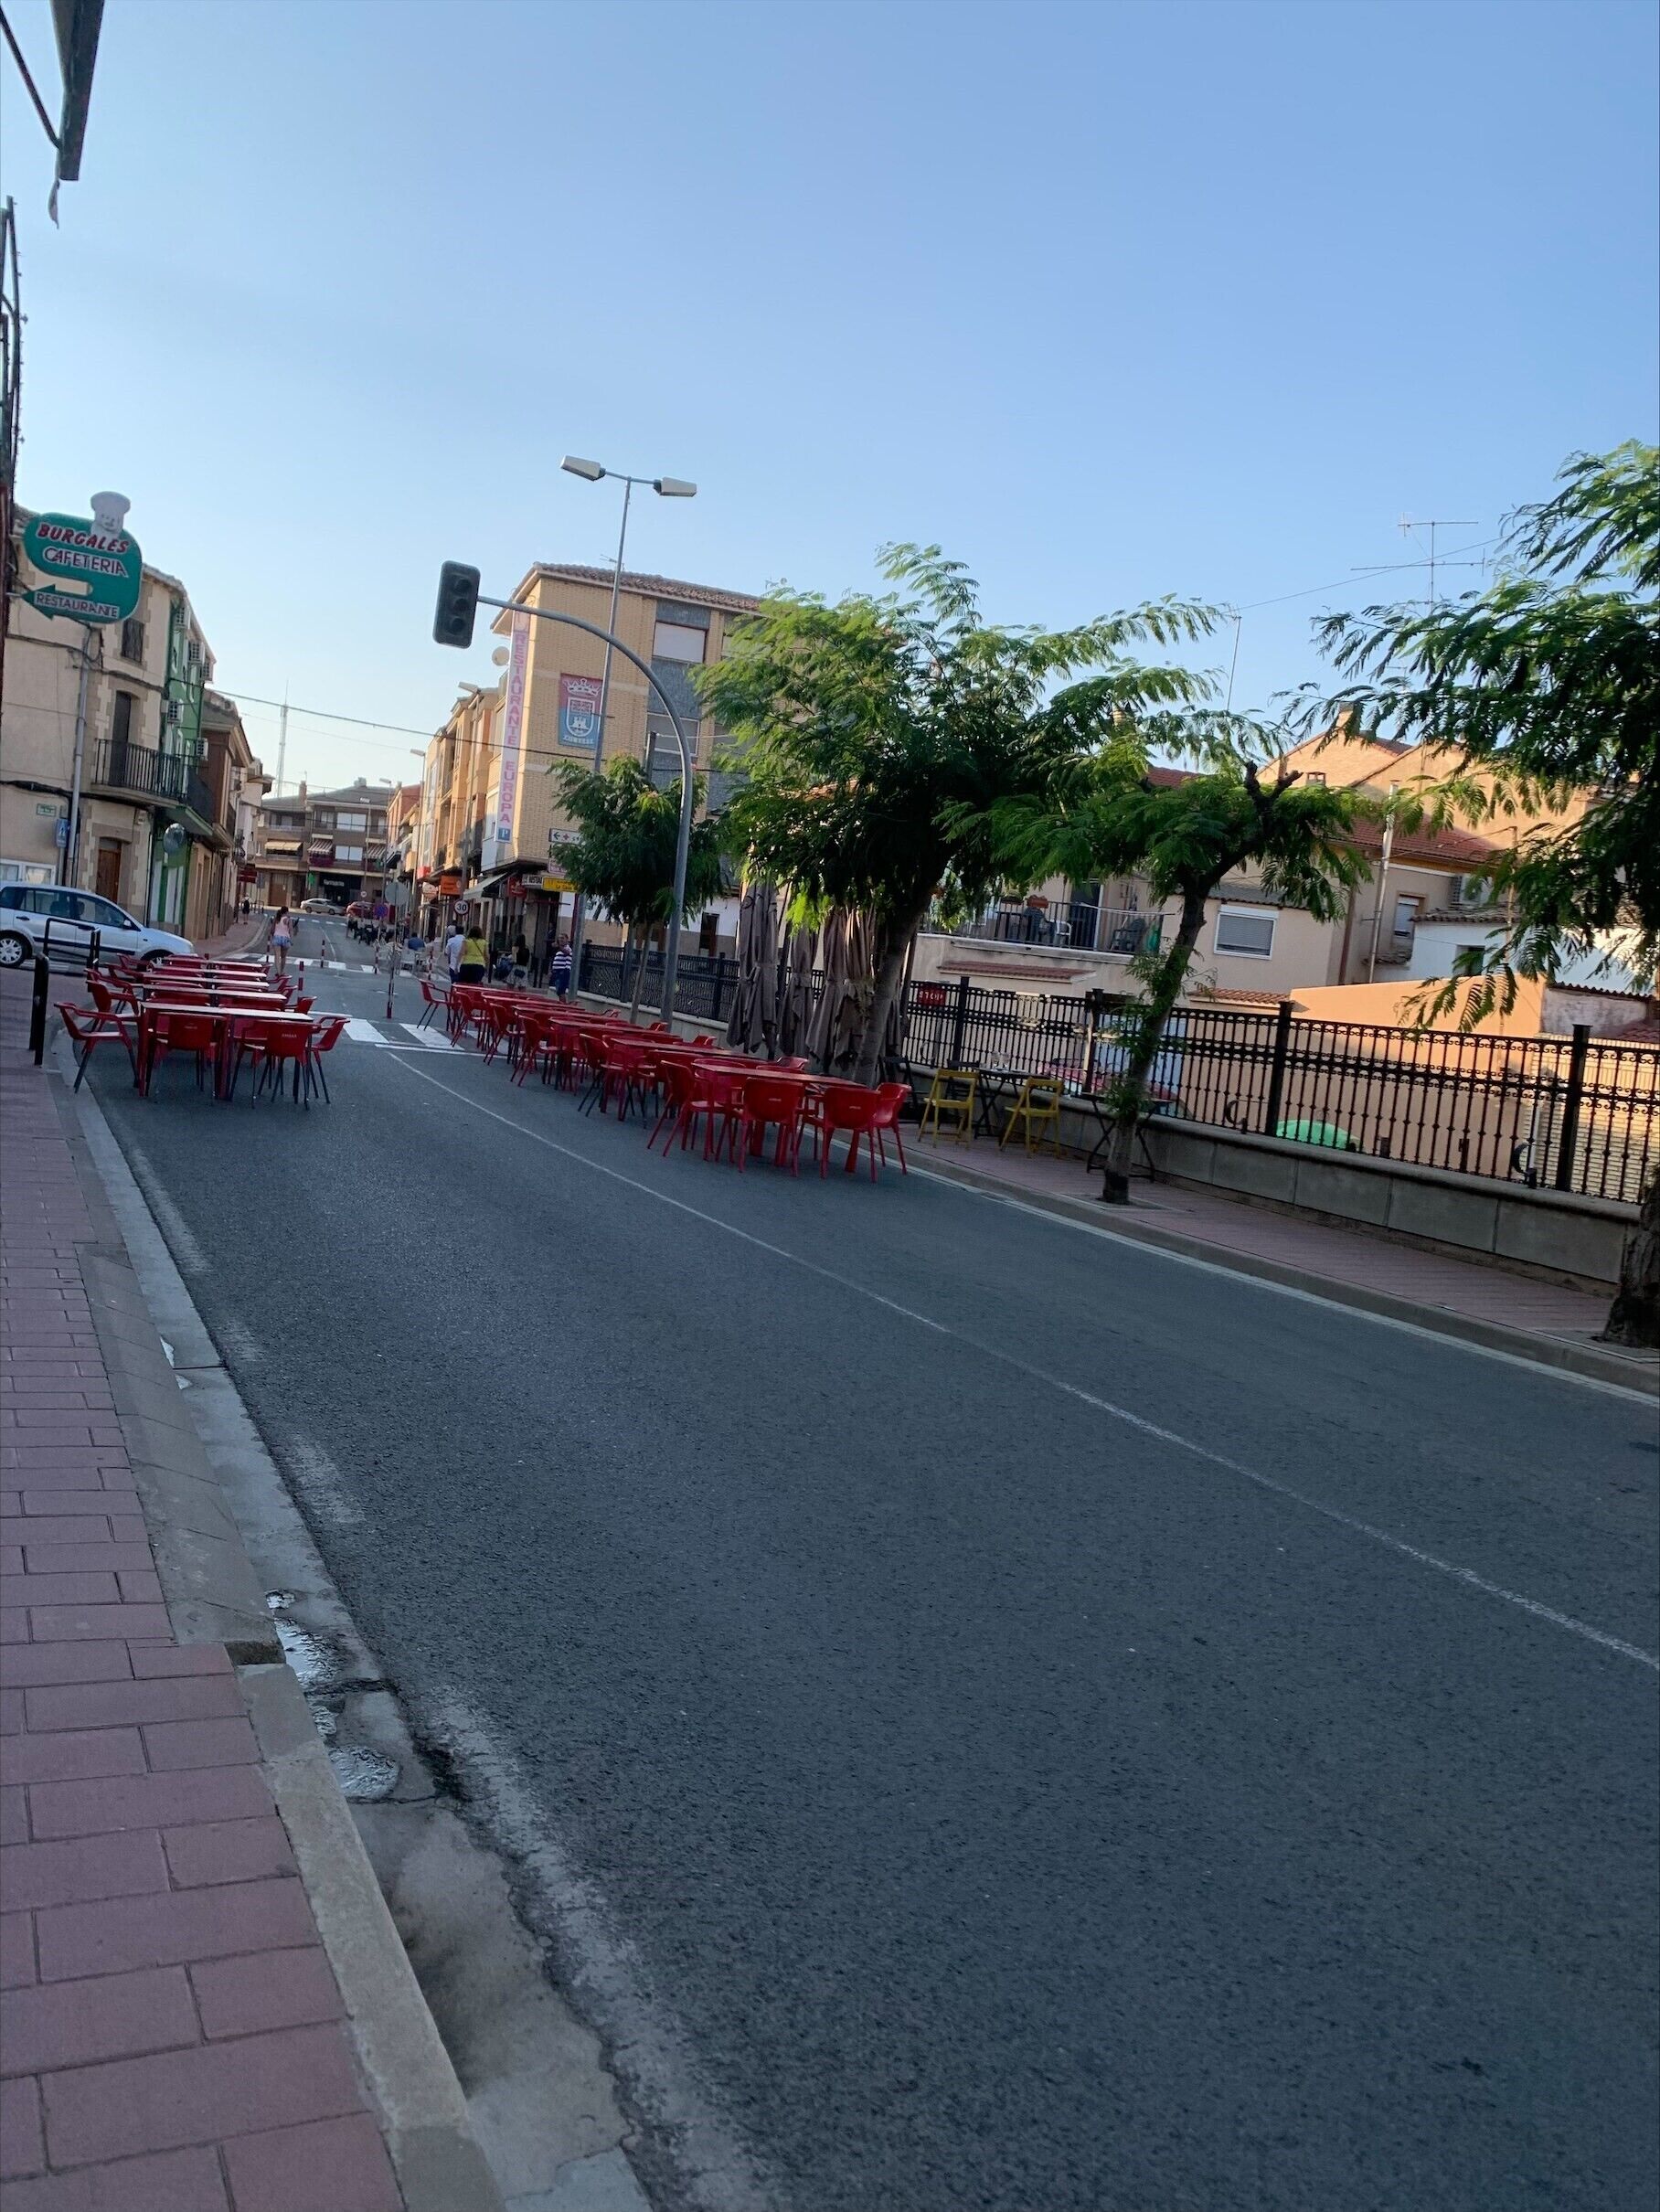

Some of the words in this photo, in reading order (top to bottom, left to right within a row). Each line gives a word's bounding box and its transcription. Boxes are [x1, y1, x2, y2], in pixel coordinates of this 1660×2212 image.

[37, 523, 130, 553] BURGALES
[43, 547, 128, 578] CAFETERIA
[36, 593, 118, 618] RESTAURANTE
[508, 633, 526, 745] RESTAURANTE
[500, 761, 515, 823] EUROPA
[457, 903, 467, 911] 30
